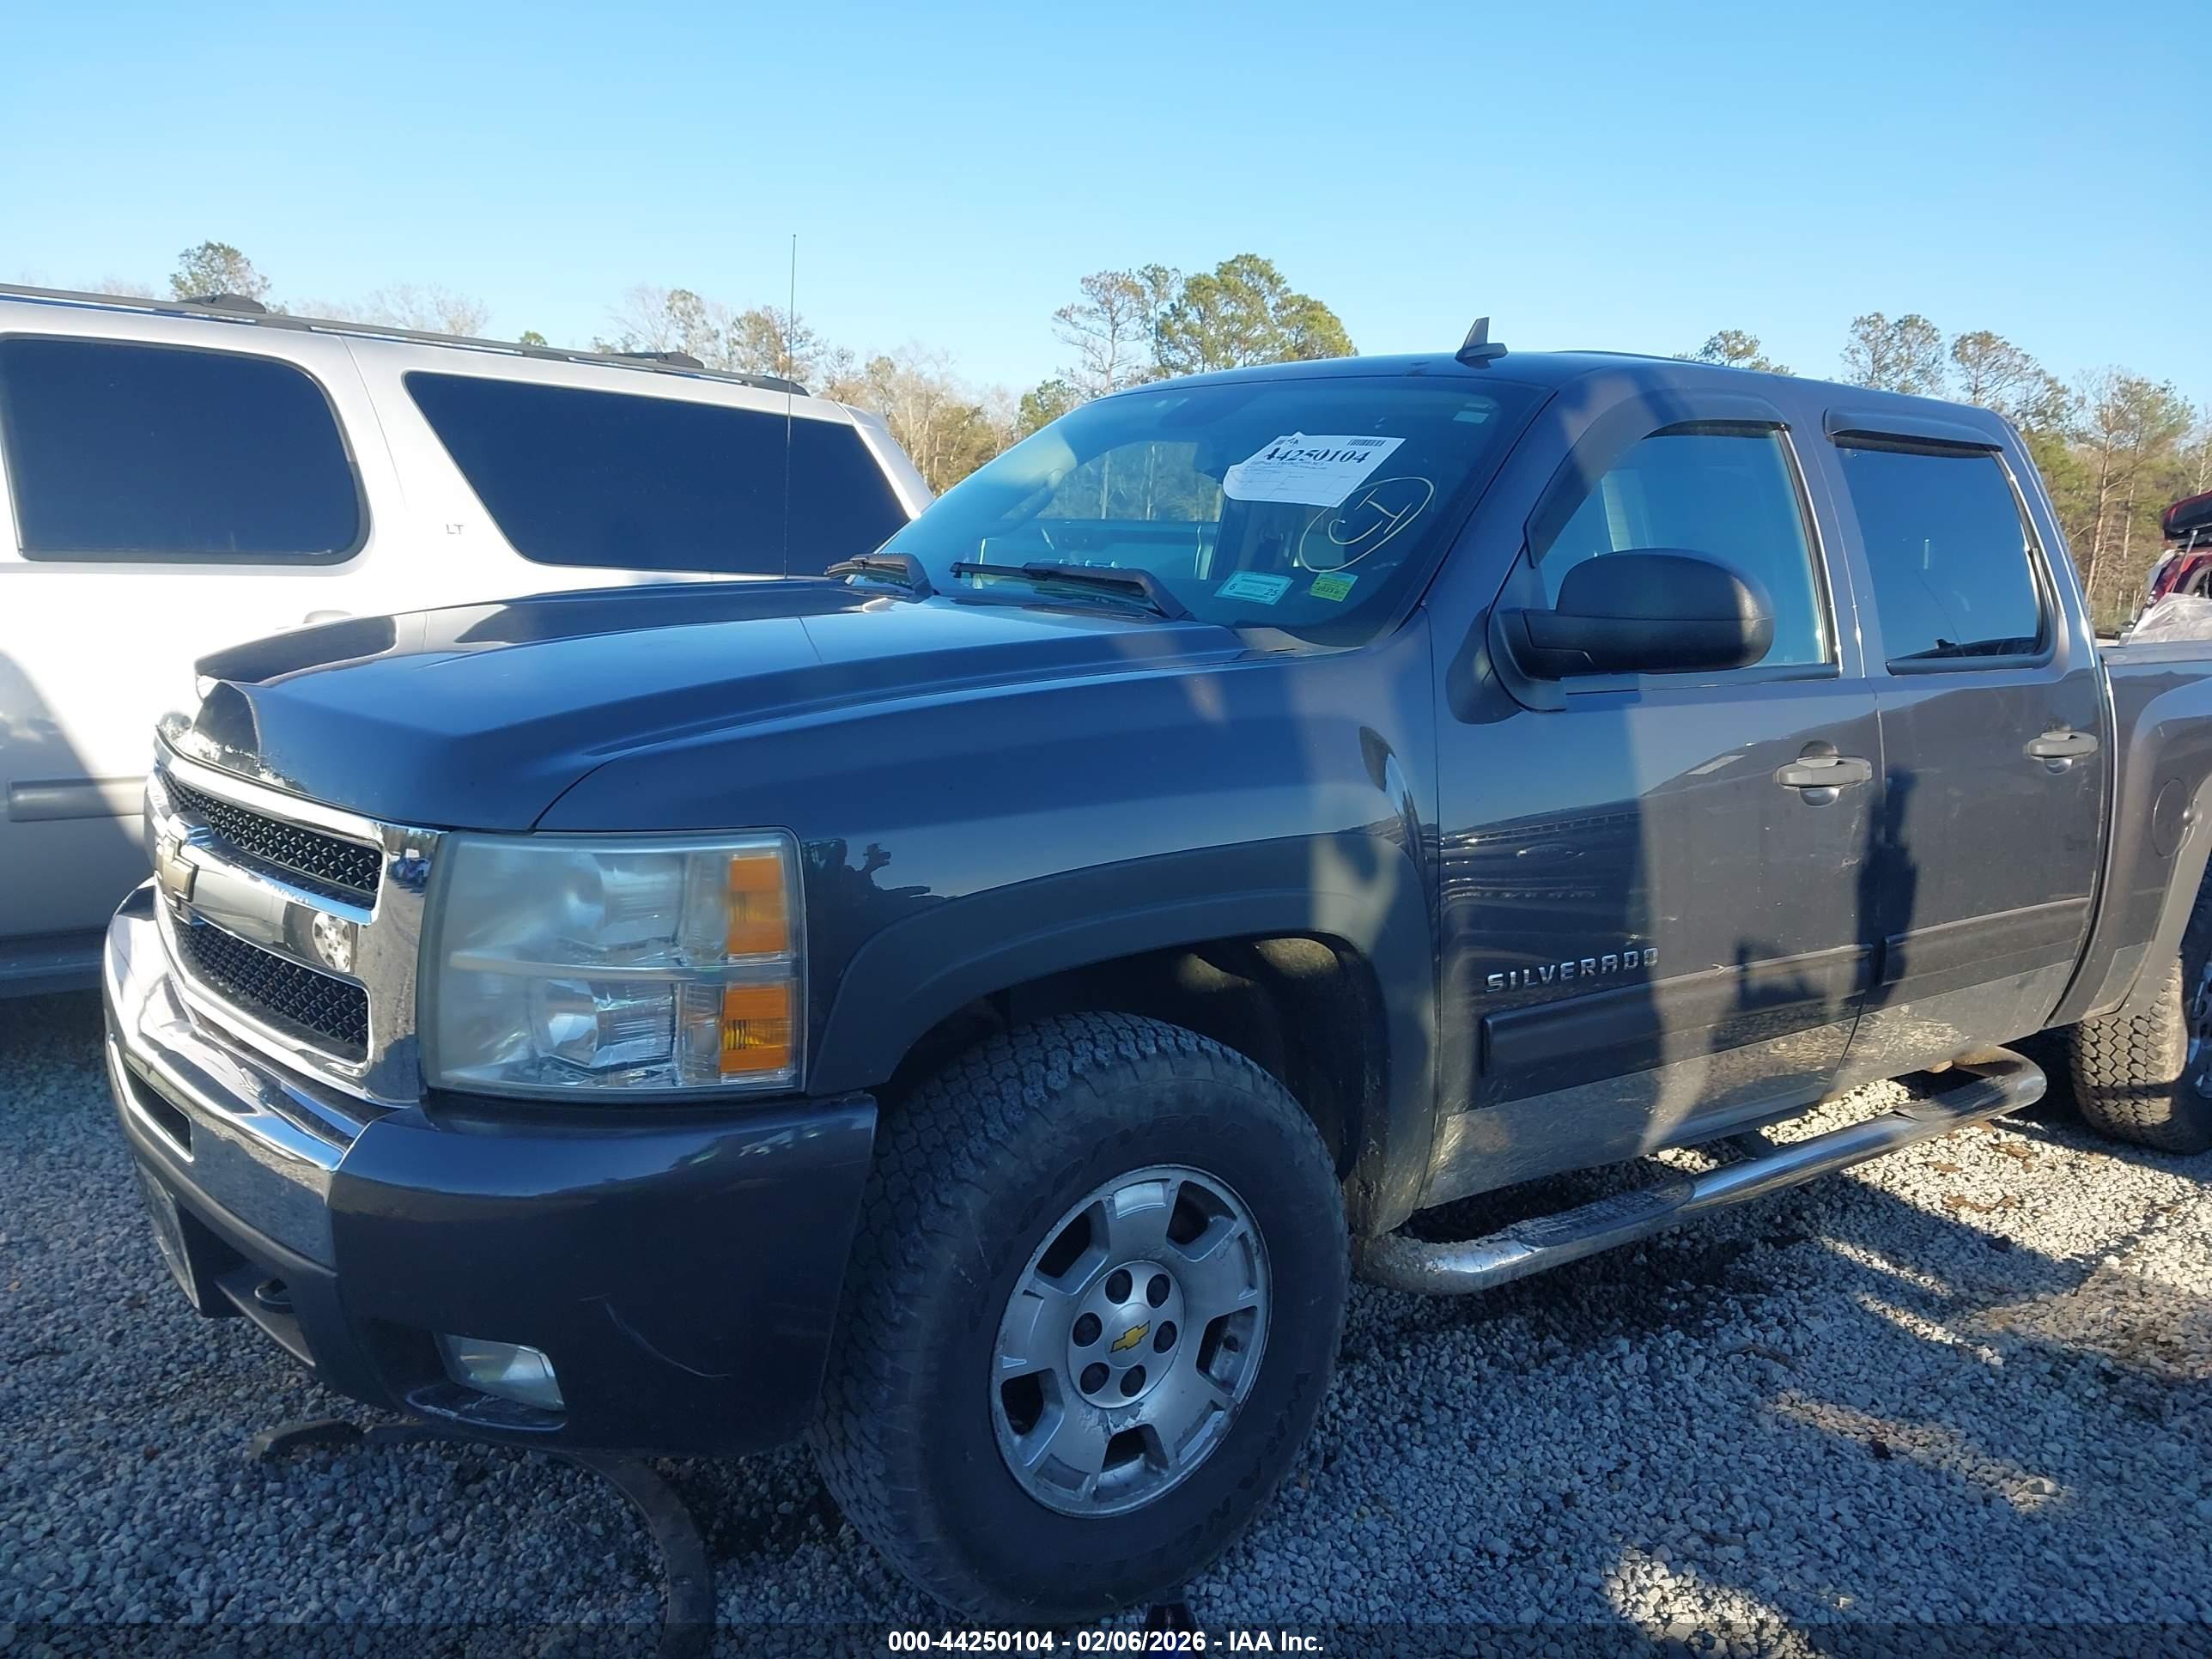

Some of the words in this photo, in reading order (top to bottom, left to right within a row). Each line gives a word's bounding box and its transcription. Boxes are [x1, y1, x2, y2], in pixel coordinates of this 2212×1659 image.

[446, 523, 465, 535] LT
[1263, 588, 1279, 597] 25
[1486, 946, 1660, 994] SILVERADO
